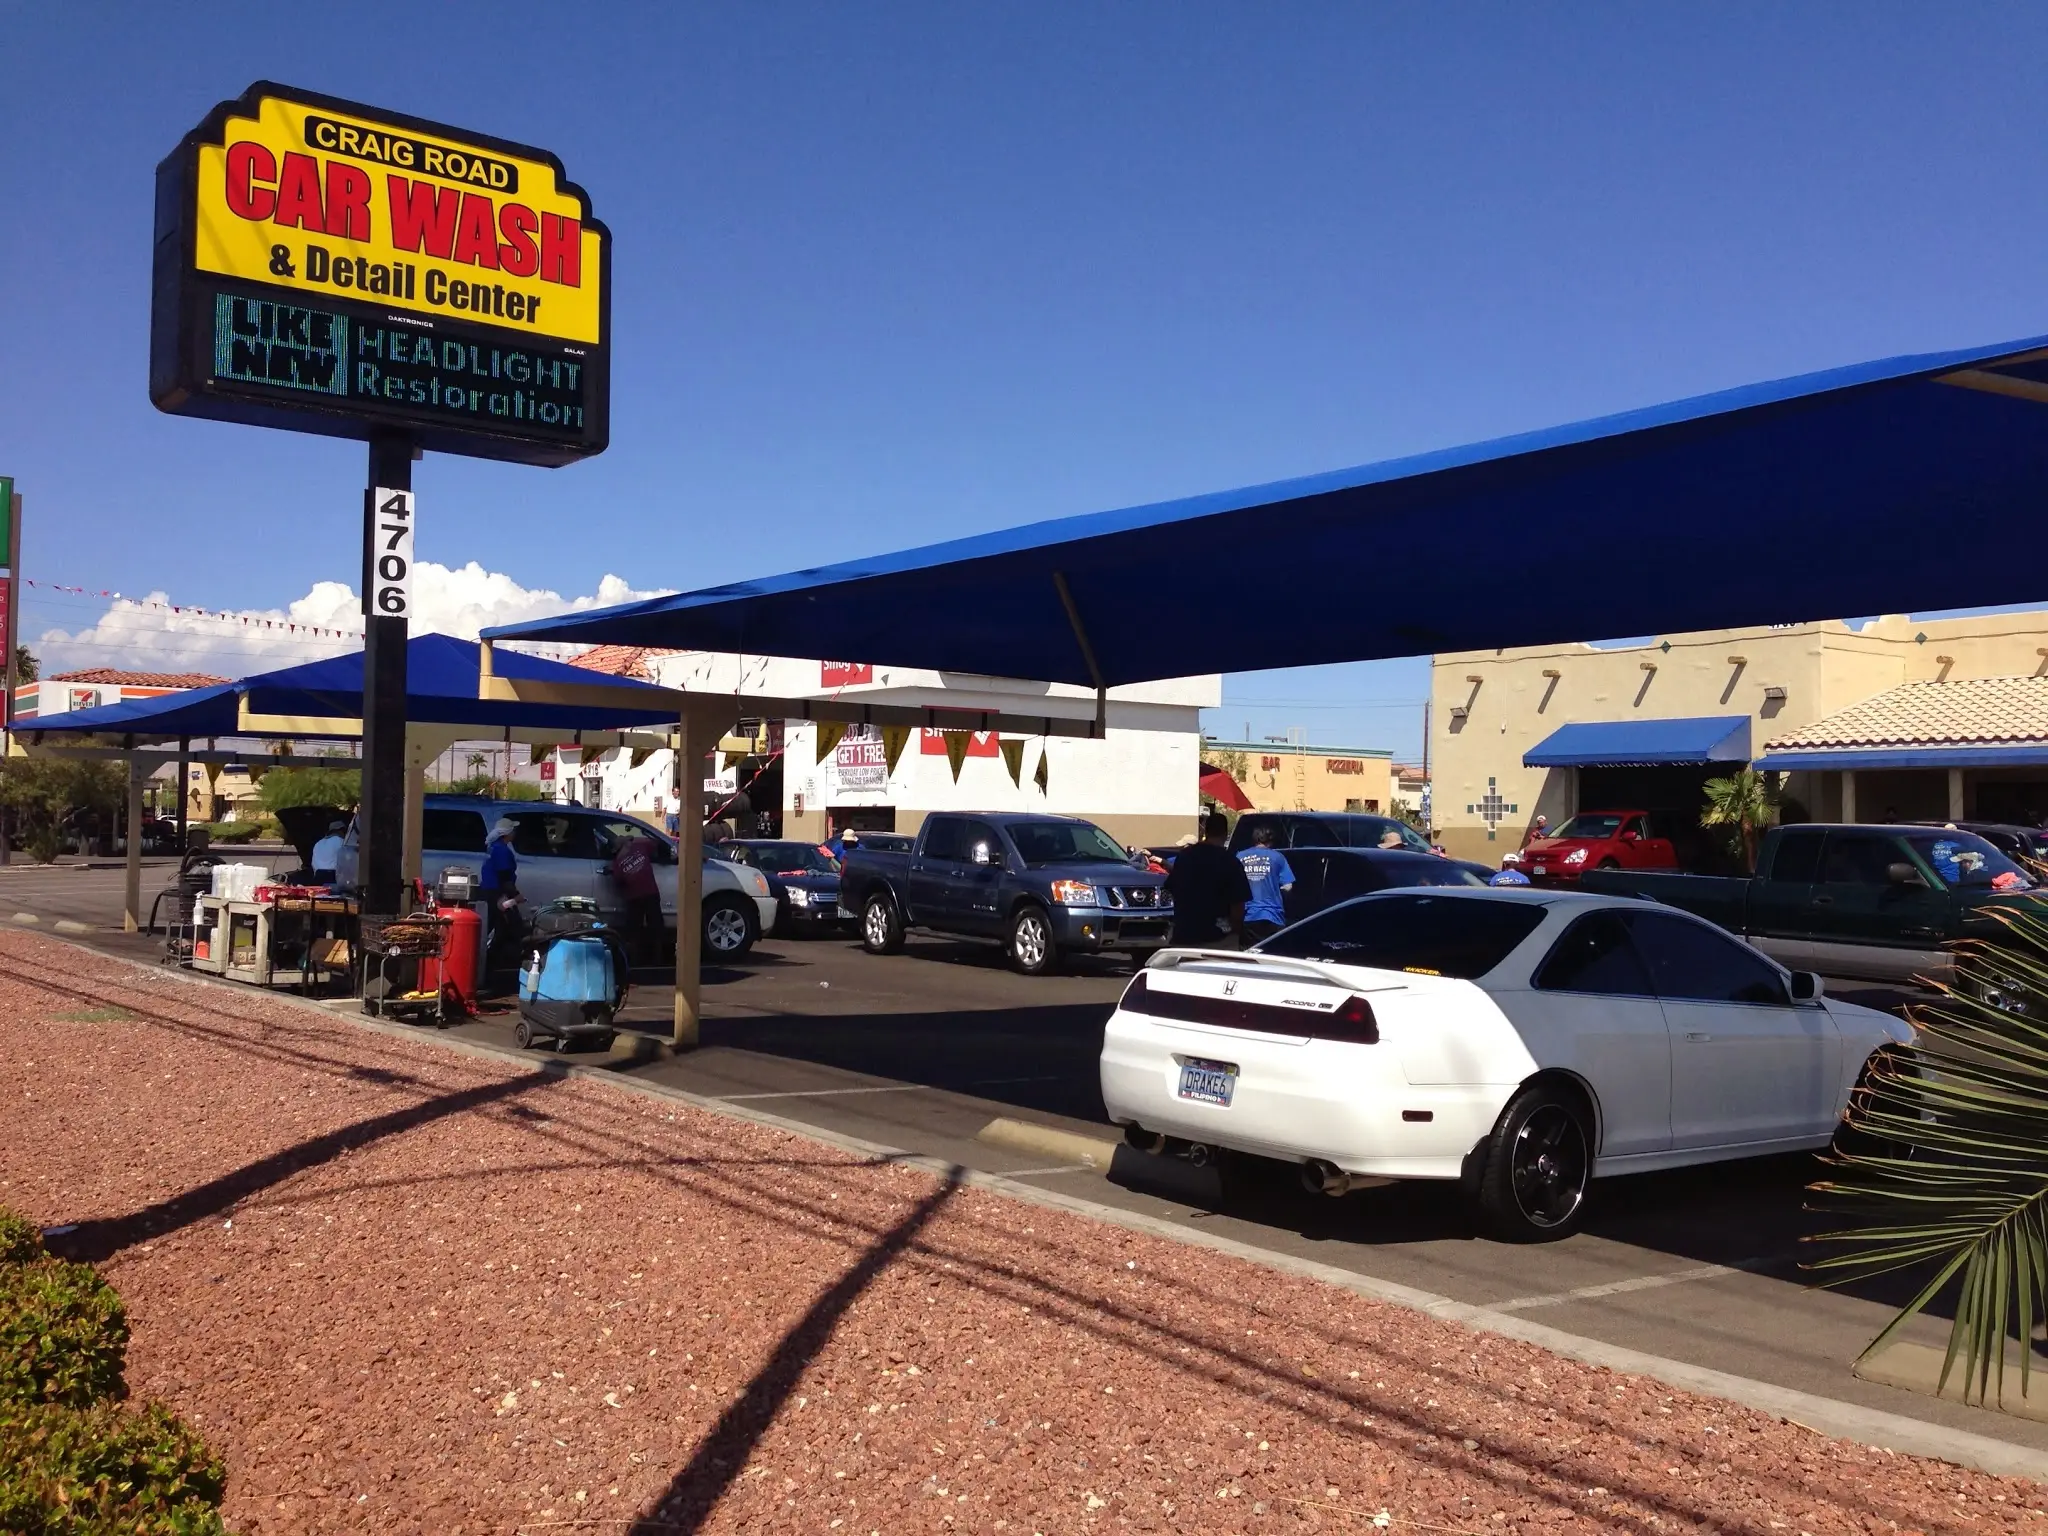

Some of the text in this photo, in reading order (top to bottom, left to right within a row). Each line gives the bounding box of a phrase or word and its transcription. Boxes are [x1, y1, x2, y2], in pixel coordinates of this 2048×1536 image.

[315, 122, 509, 188] CRAIG ROAD
[225, 141, 582, 289] CAR WASH
[269, 244, 541, 323] & Detail Center
[232, 299, 334, 349] LIKE
[358, 326, 582, 391] HEADLIGHT
[358, 362, 584, 428] Restoration
[377, 493, 411, 614] 4706
[837, 745, 855, 764] GET
[856, 745, 862, 763] 1
[1280, 999, 1316, 1007] ACCORD
[1185, 1070, 1227, 1096] DRAKE6
